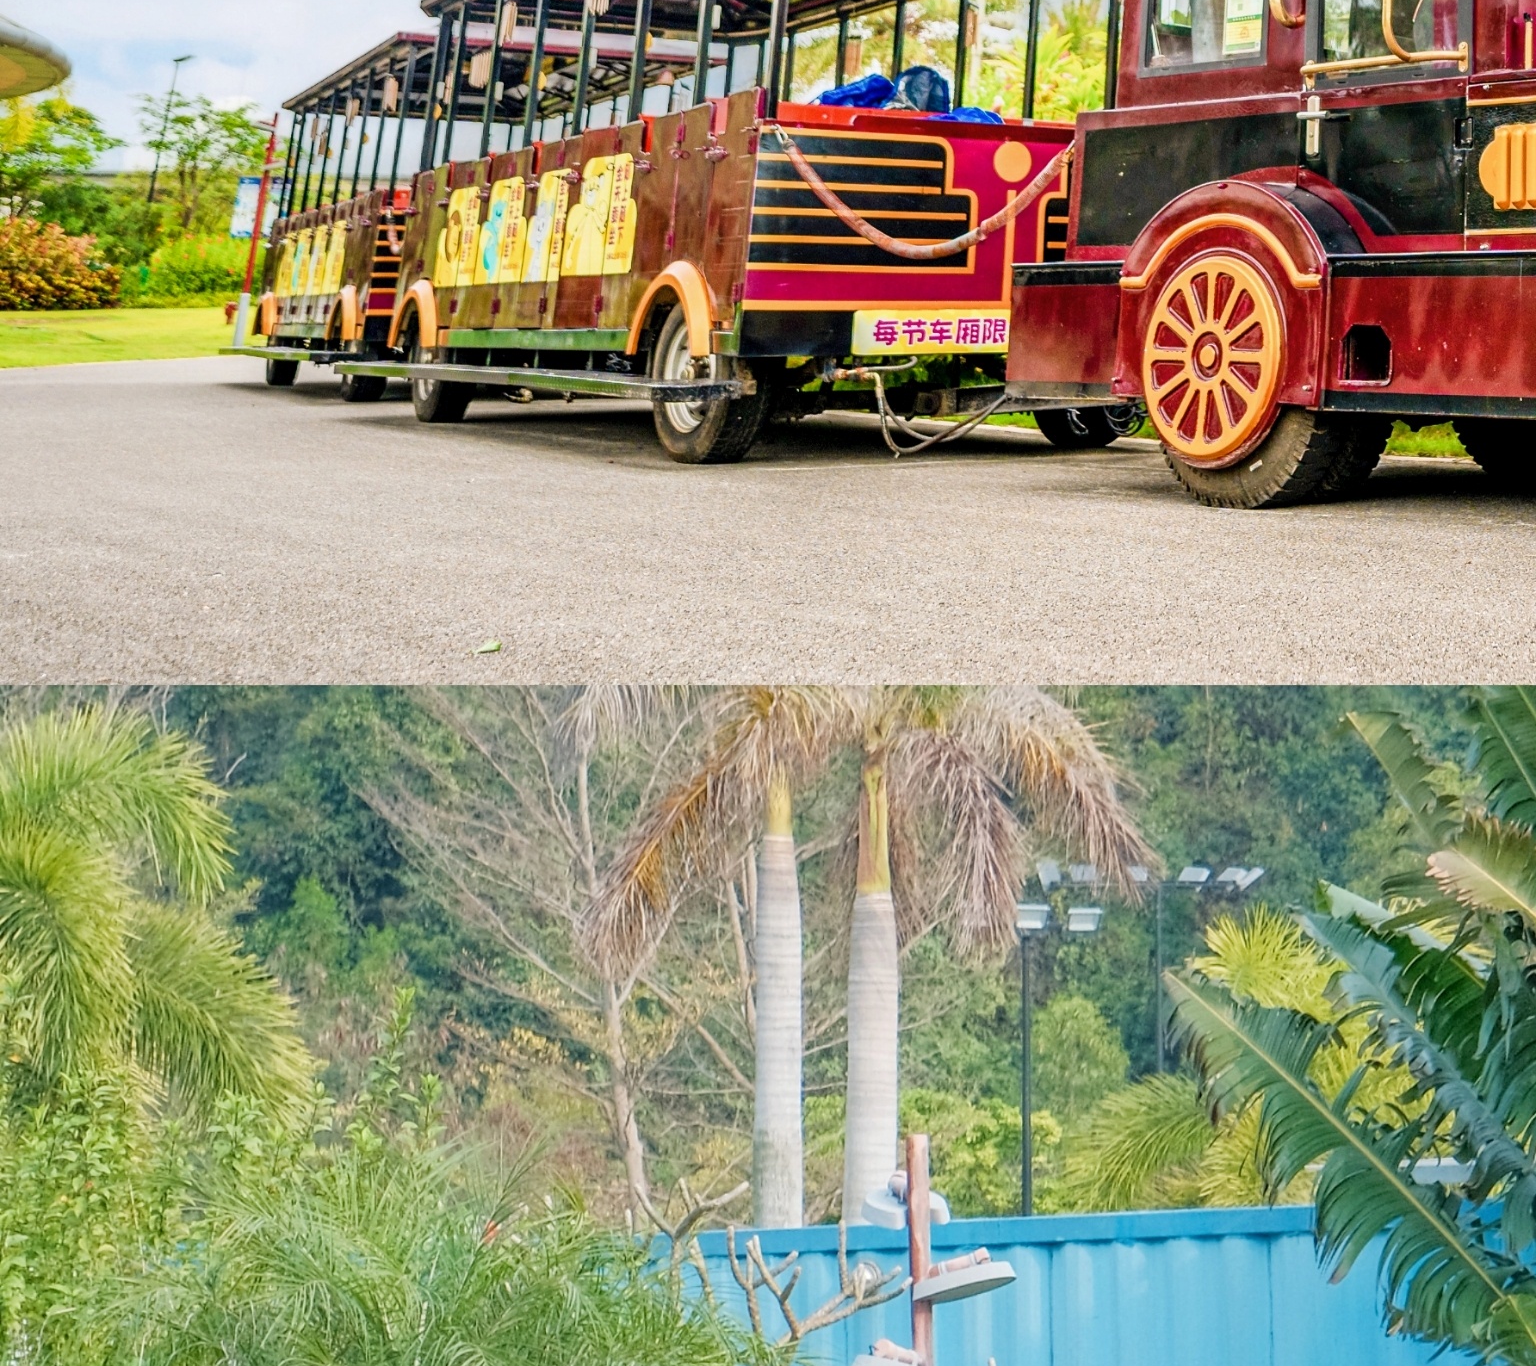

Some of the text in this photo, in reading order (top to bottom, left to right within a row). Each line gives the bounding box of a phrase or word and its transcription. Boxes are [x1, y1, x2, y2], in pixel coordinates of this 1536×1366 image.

[873, 318, 1007, 346] 每节车厢限
